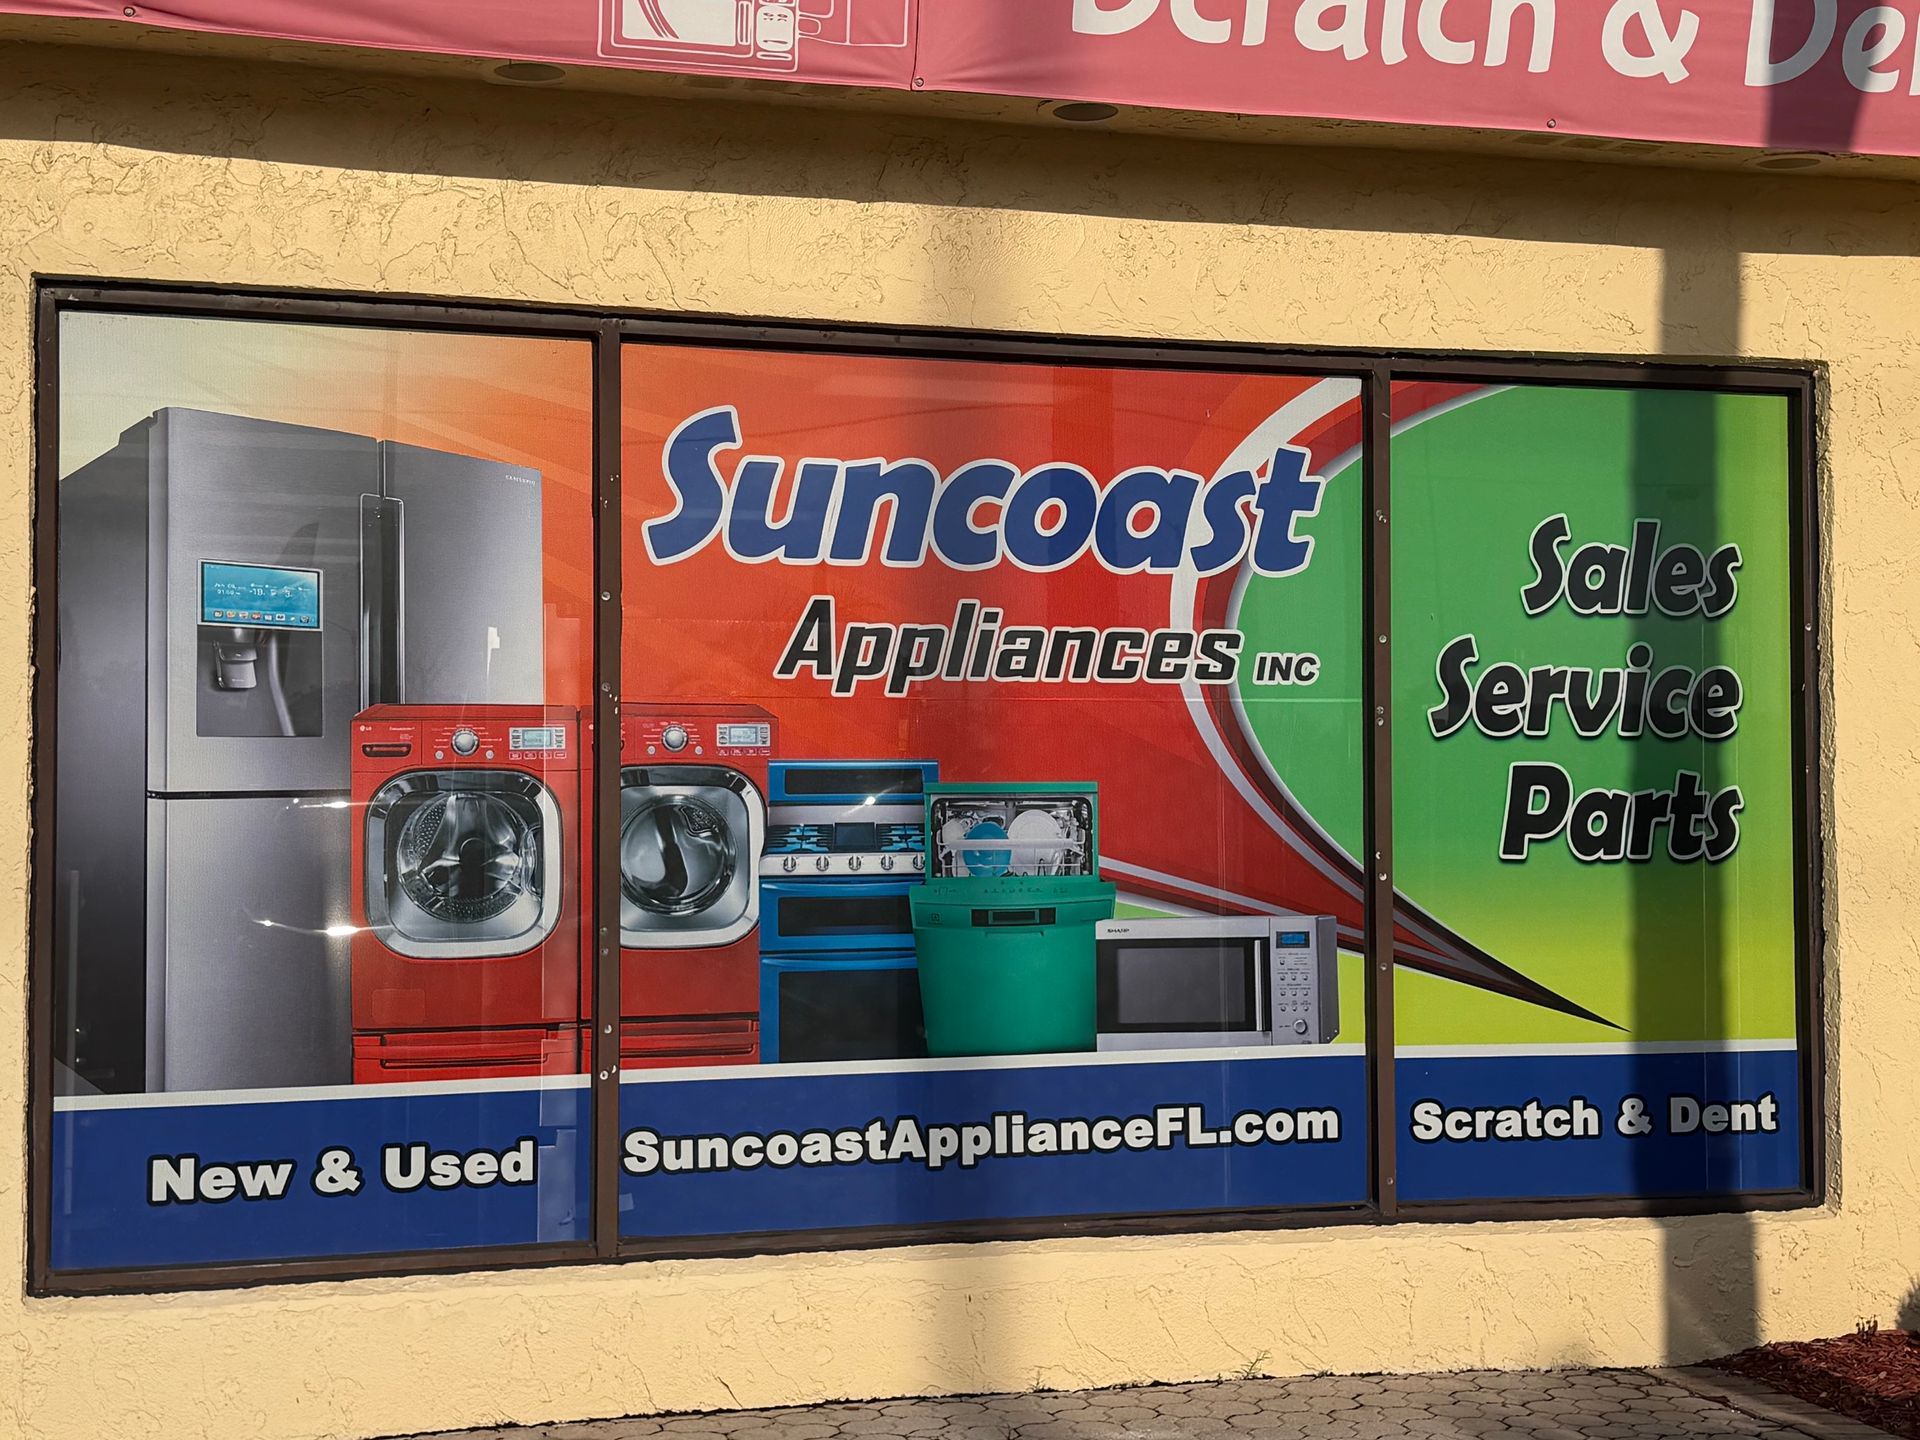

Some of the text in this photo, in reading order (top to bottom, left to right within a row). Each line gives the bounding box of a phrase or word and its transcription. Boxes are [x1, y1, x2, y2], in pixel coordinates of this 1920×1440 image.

[1601, 0, 1700, 85] &
[1743, 0, 1920, 96] De
[641, 404, 1326, 578] Suncoast
[1520, 512, 1743, 618] Sales
[775, 595, 1321, 698] Appliances INC
[1427, 633, 1743, 739] Service
[1498, 761, 1744, 862] Parts
[622, 1107, 1341, 1174] SuncoastApplianceFL.com
[1411, 1092, 1779, 1141] Scratch & Dent
[149, 1139, 537, 1203] New & Used
